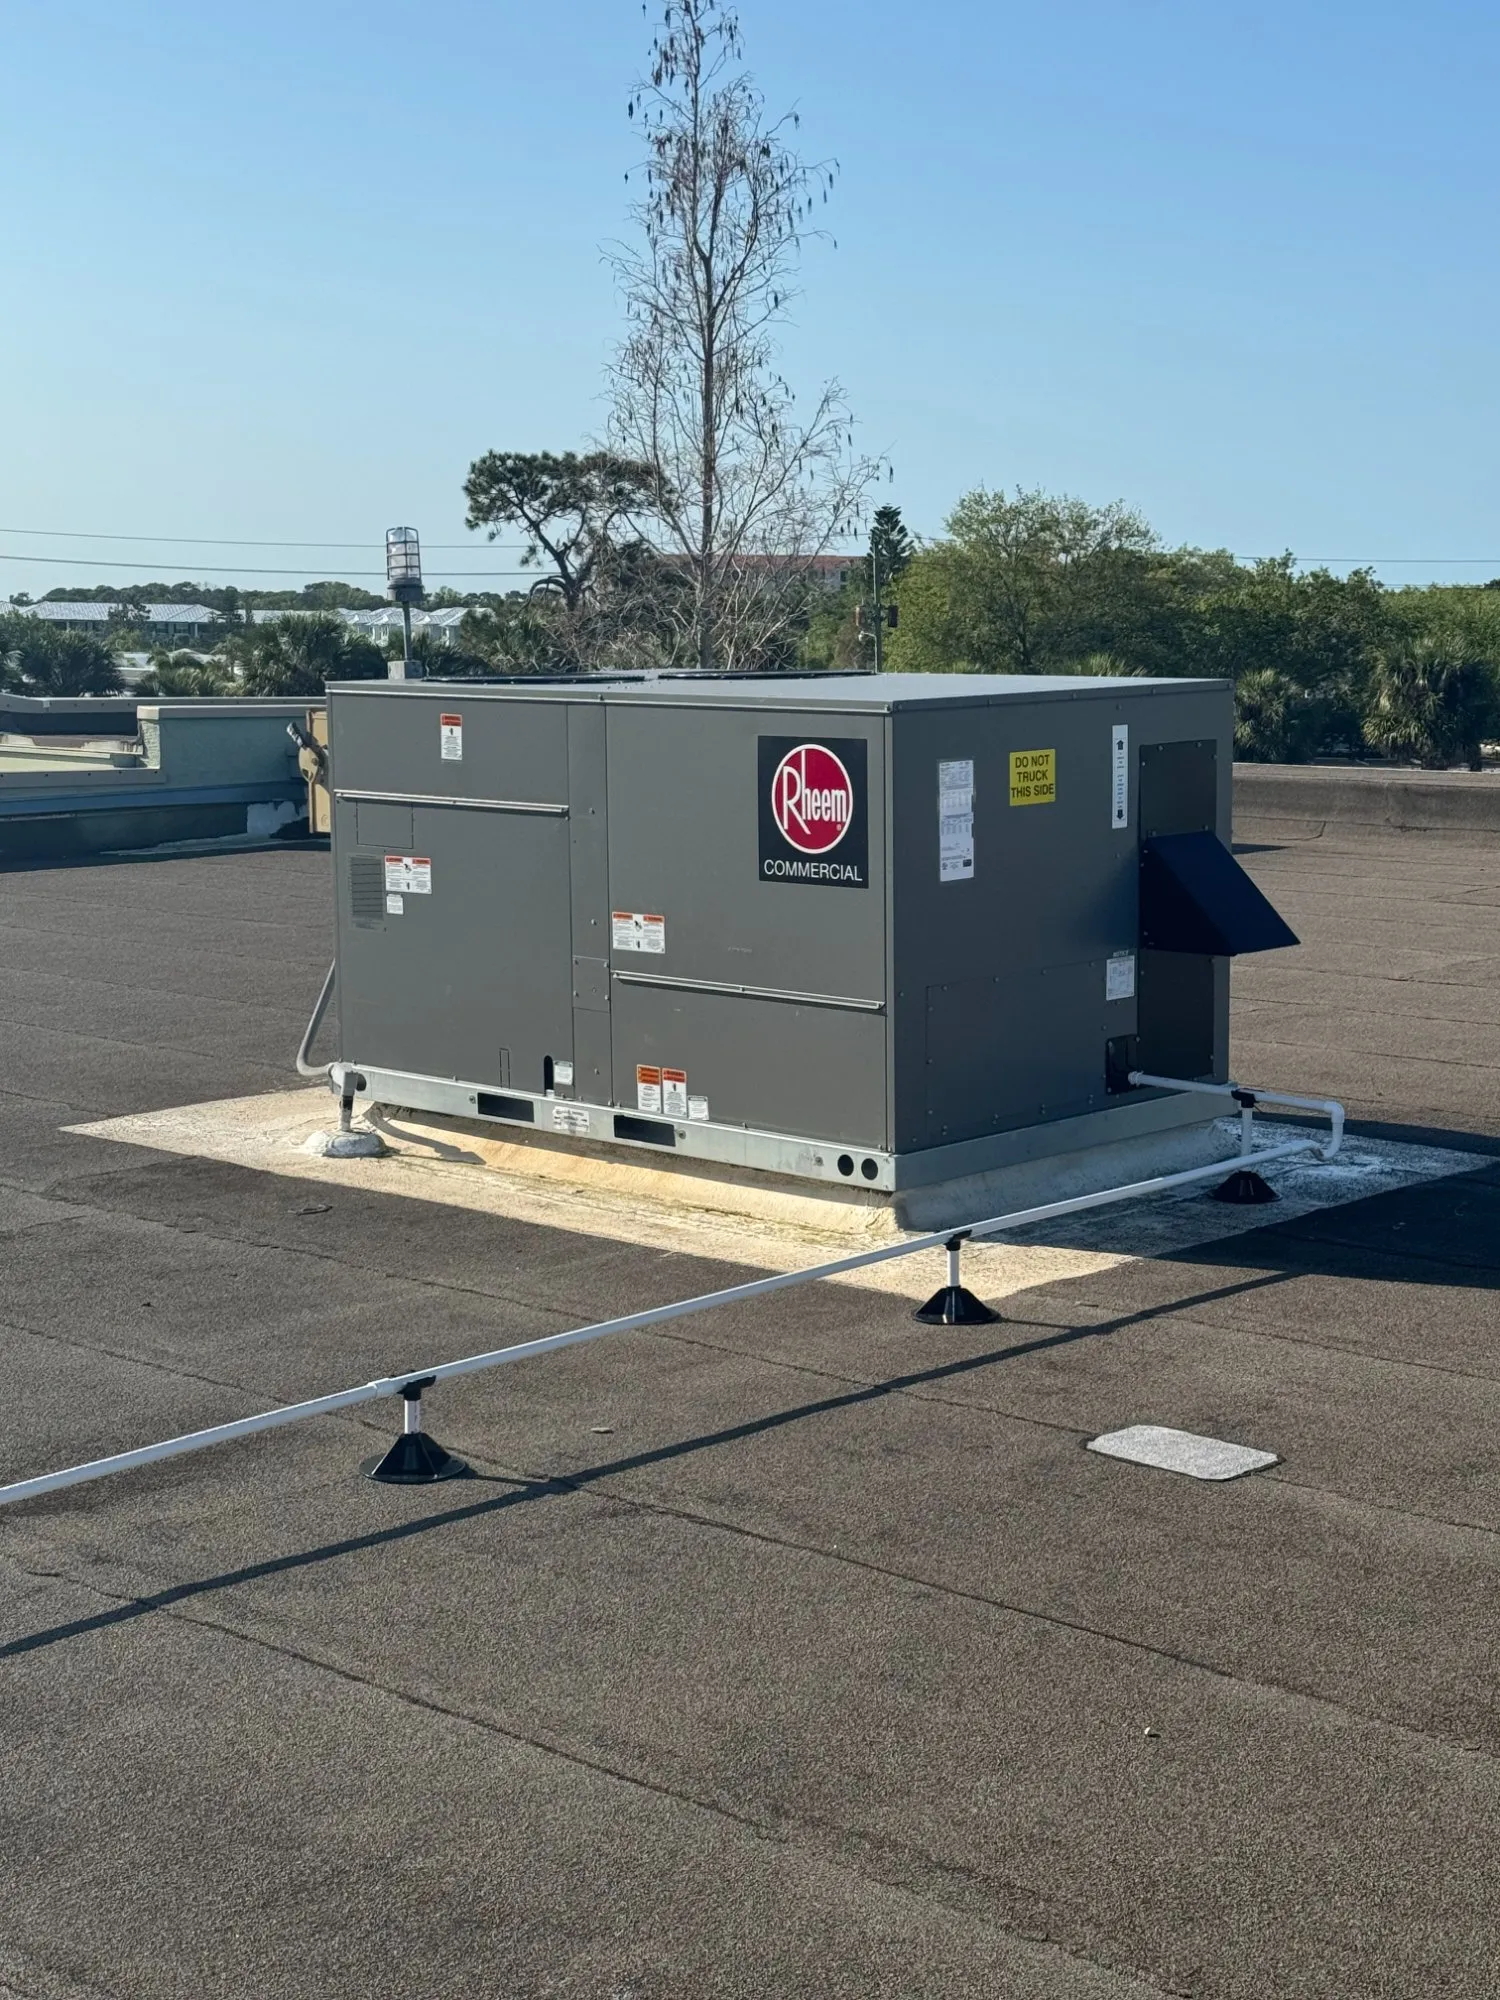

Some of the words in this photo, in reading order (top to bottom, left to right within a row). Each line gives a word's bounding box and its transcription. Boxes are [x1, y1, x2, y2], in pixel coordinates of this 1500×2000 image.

[1015, 756, 1029, 768] DO
[1031, 754, 1050, 767] NOT
[1016, 769, 1048, 782] TRUCK
[782, 749, 847, 835] Rheem
[1011, 785, 1031, 798] THIS
[1034, 783, 1054, 796] SIDE
[763, 859, 863, 881] COMMERCIAL
